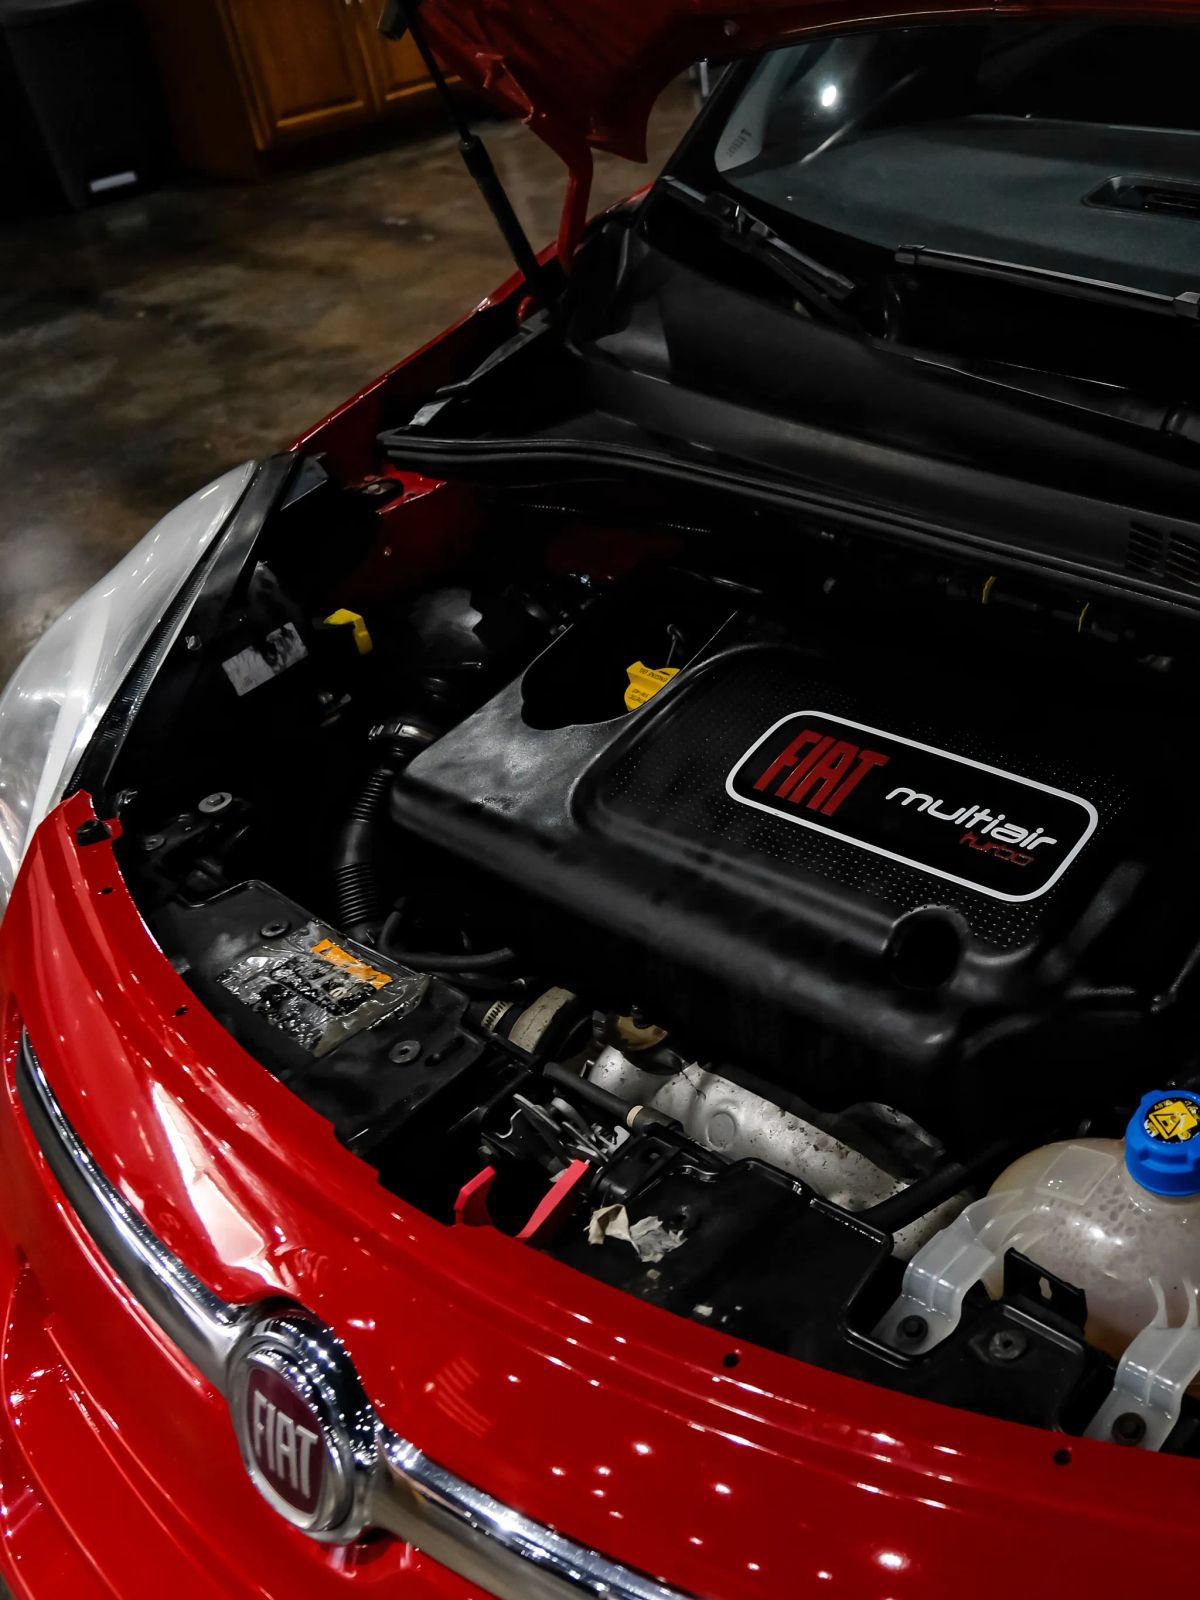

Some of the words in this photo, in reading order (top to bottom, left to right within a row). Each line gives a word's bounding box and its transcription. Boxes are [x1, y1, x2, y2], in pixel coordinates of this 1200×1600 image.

[753, 729, 891, 817] FIAT
[885, 787, 1058, 851] multiair
[959, 831, 1036, 867] turbo
[253, 1389, 319, 1499] FIAT
